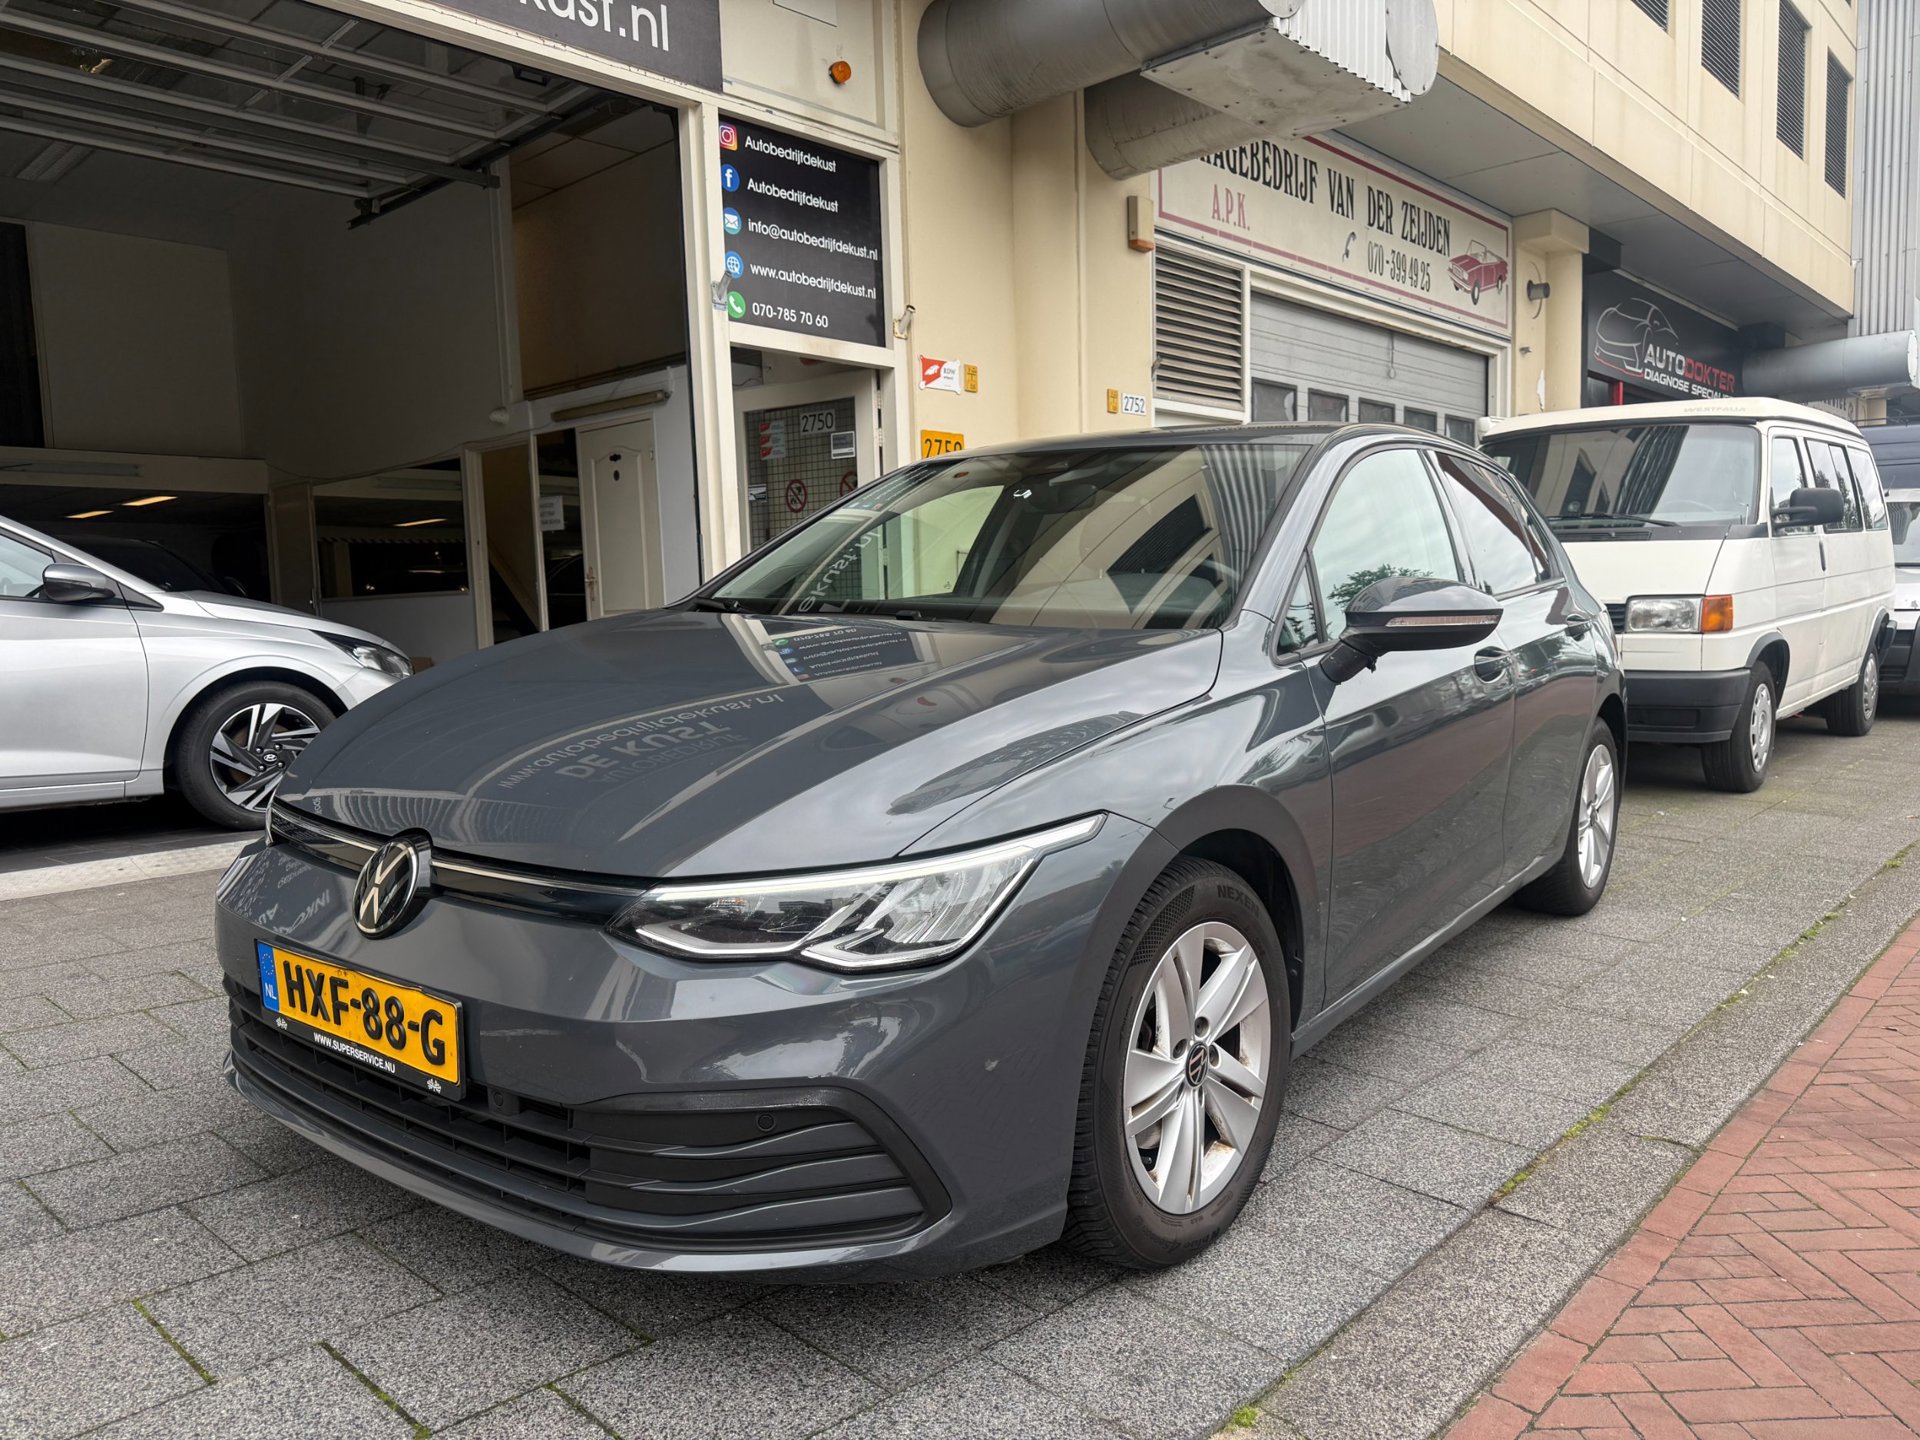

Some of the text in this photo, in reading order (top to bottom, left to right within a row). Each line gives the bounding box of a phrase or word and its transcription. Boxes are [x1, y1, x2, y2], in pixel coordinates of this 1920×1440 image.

[745, 136, 837, 172] Autobedrijfdekust
[747, 178, 839, 213] Autobedrijfdekust
[1211, 183, 1251, 231] A.P.K.
[1327, 167, 1355, 221] VAN
[1366, 185, 1394, 235] DER
[1401, 200, 1451, 258] ZEIJDEN
[748, 219, 879, 261] info@autobedrijfdekust.nl
[750, 263, 877, 299] www.autobedrijfdekust.nl
[1408, 256, 1419, 288] 49
[1420, 261, 1431, 293] 25
[752, 302, 829, 328] 070-785 70 60
[1644, 343, 1736, 393] AUTODOKTER
[1644, 368, 1690, 393] DIAGNOSE
[802, 411, 834, 433] 2750
[1124, 395, 1145, 413] 2752
[265, 982, 277, 1000] NL
[283, 960, 445, 1066] HXF-88-G
[313, 1032, 396, 1074] WWW.SUPERSERVICE.NU
